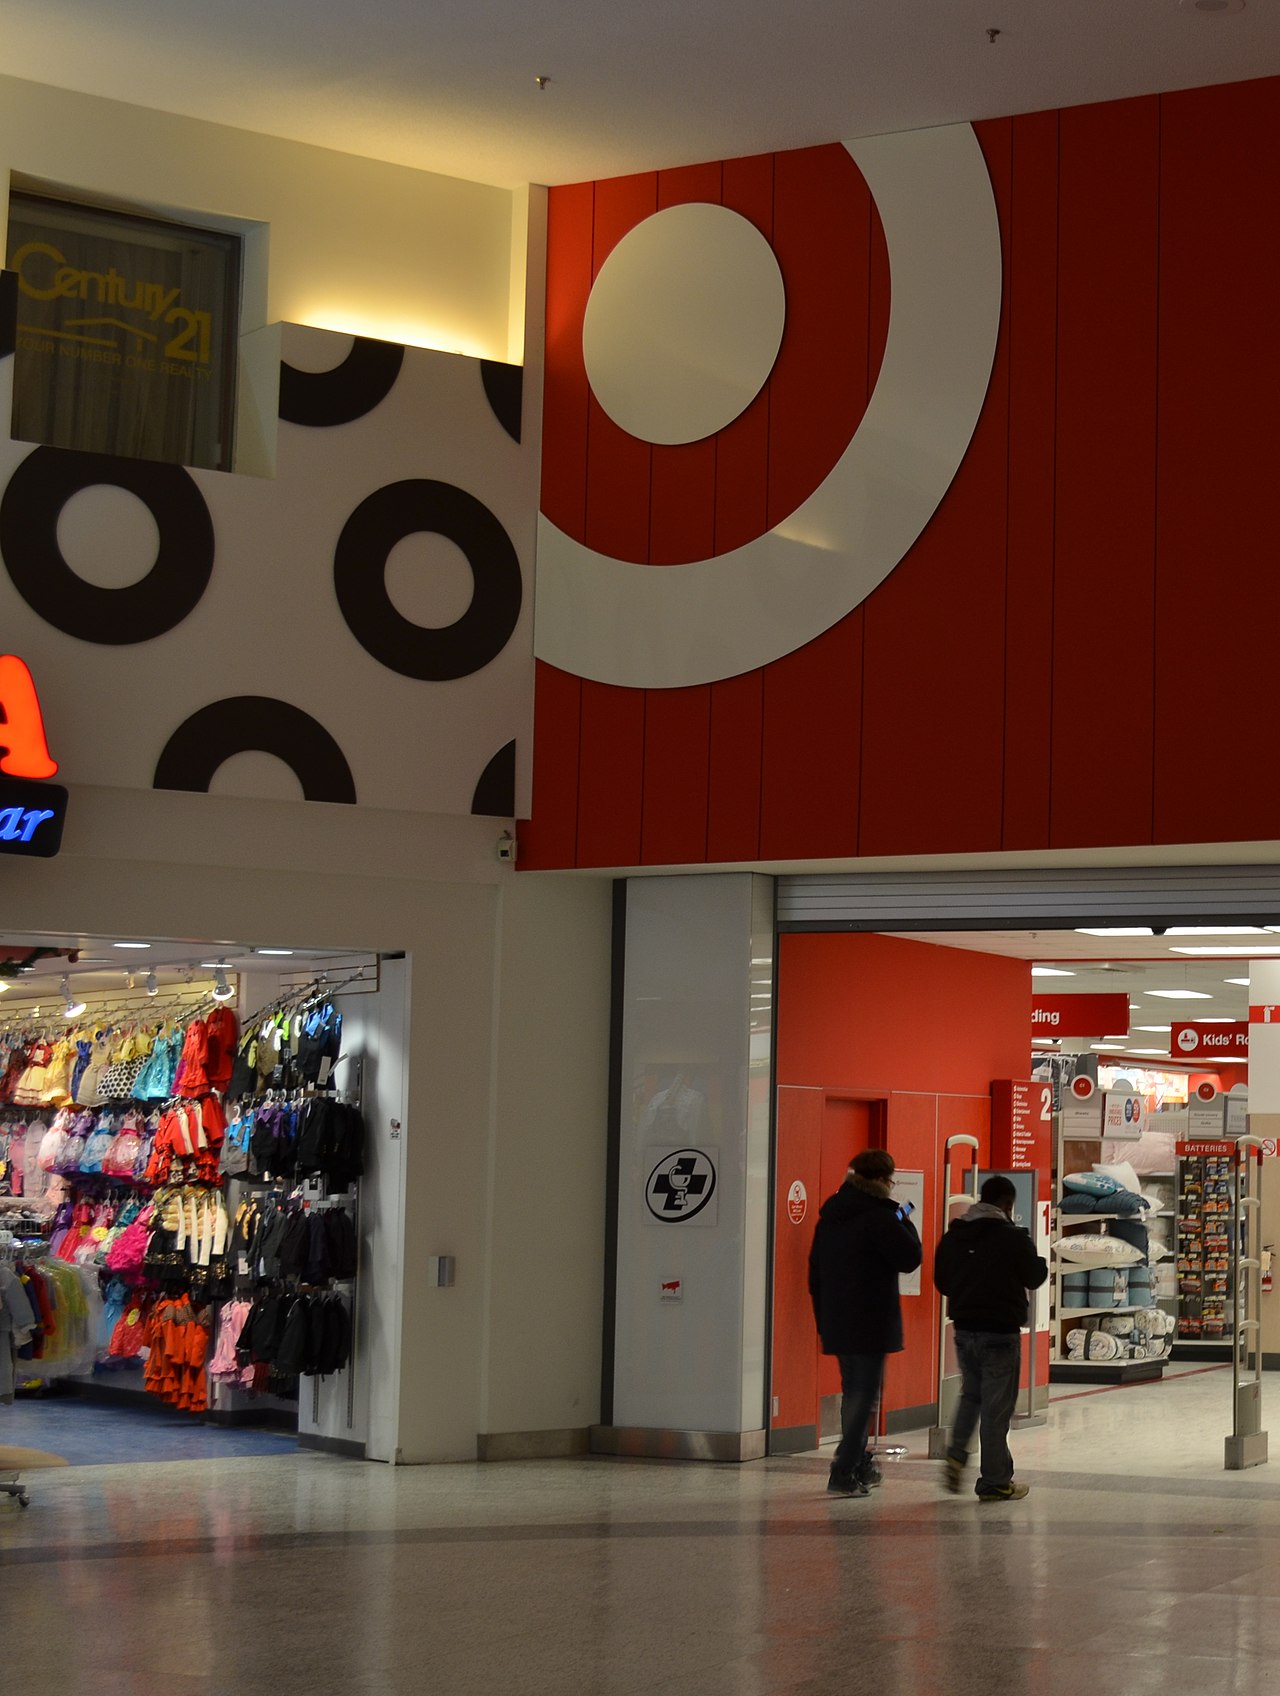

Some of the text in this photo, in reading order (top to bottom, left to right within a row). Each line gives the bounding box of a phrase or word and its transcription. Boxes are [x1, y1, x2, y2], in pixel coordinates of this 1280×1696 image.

[12, 241, 181, 321] Century
[164, 307, 212, 364] 21
[61, 346, 121, 363] NUMBER
[125, 355, 156, 372] ONE
[160, 361, 214, 379] REALTY
[1203, 1034, 1233, 1046] Kids'
[1040, 1088, 1052, 1120] 2
[1184, 1144, 1228, 1153] BATTERIES
